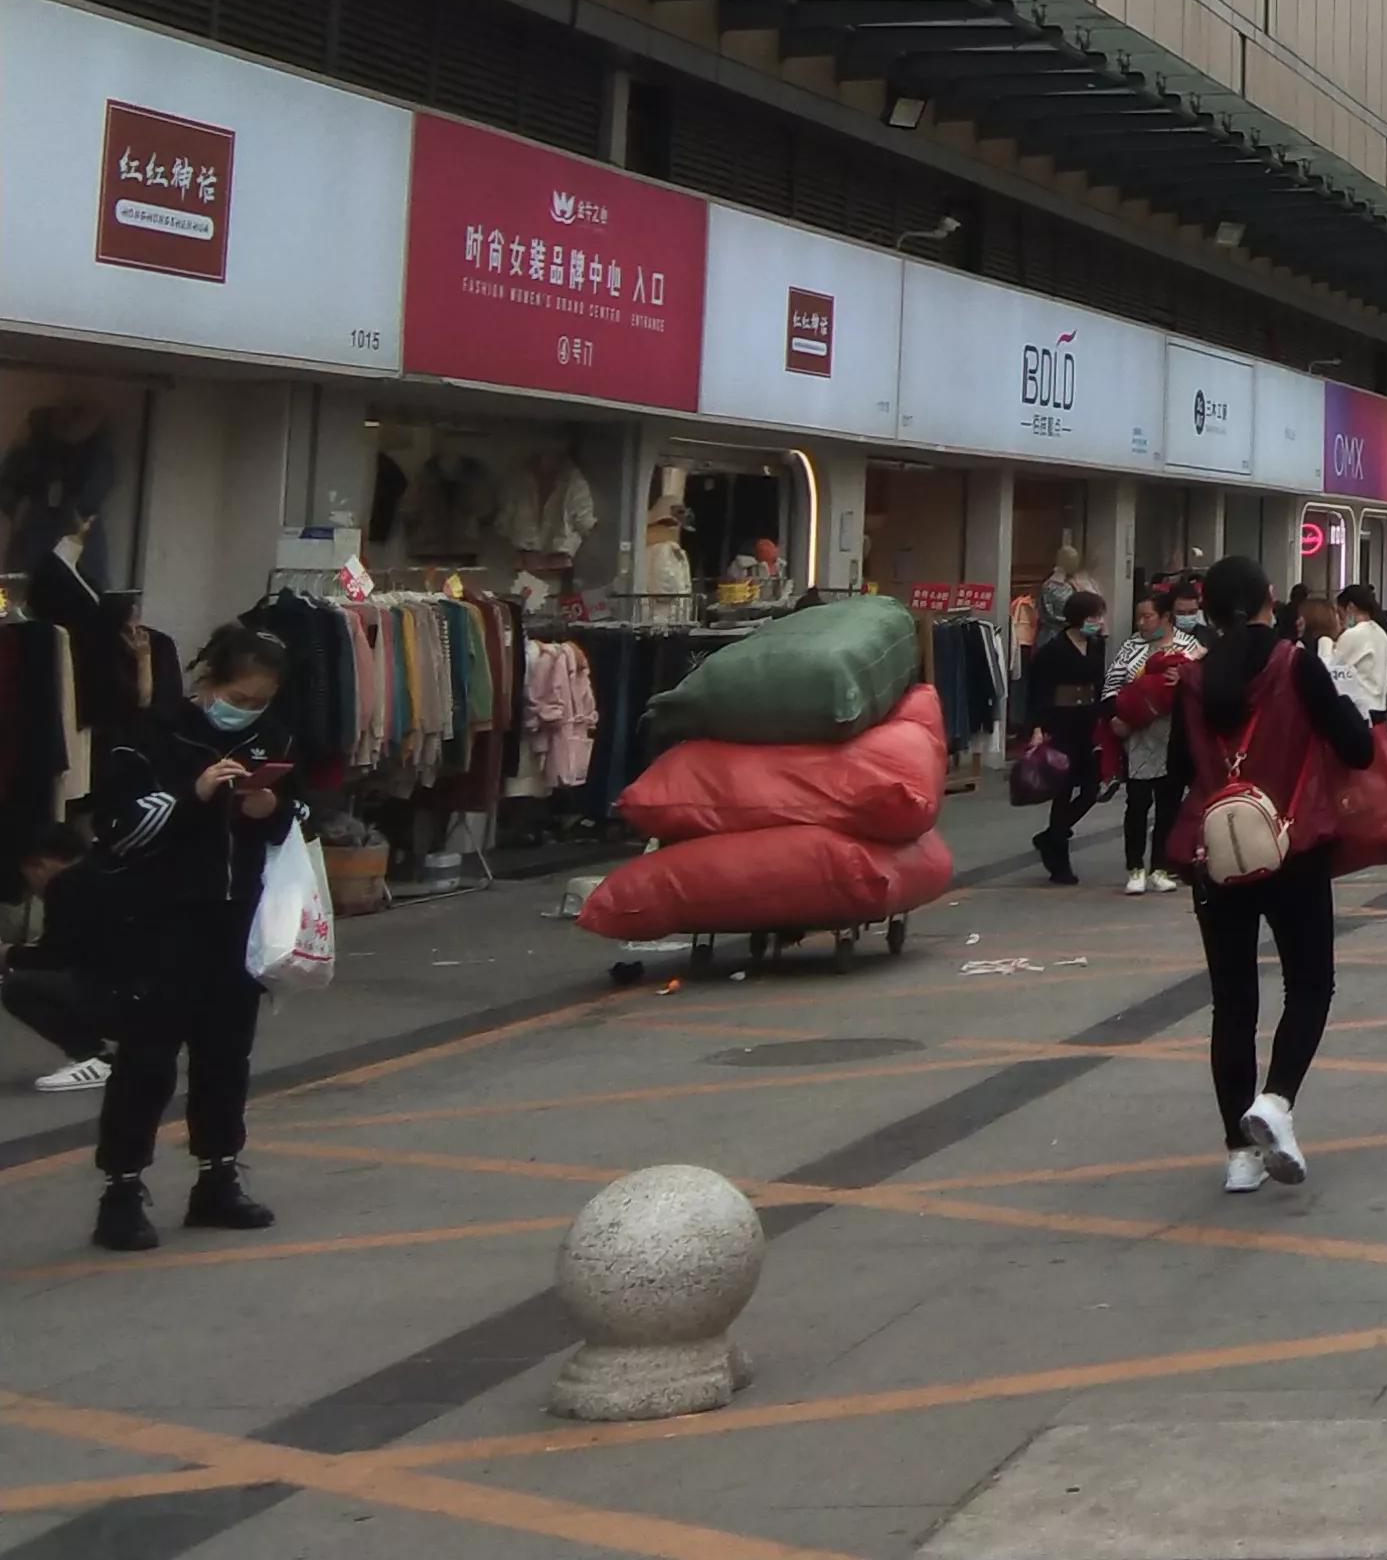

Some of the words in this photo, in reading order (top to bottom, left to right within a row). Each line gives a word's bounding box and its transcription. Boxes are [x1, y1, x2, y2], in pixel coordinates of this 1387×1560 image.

[465, 224, 621, 297] 时尚女装品牌中心
[632, 265, 665, 306] 入口
[351, 329, 381, 351] 1015
[1021, 344, 1075, 410] BOLD
